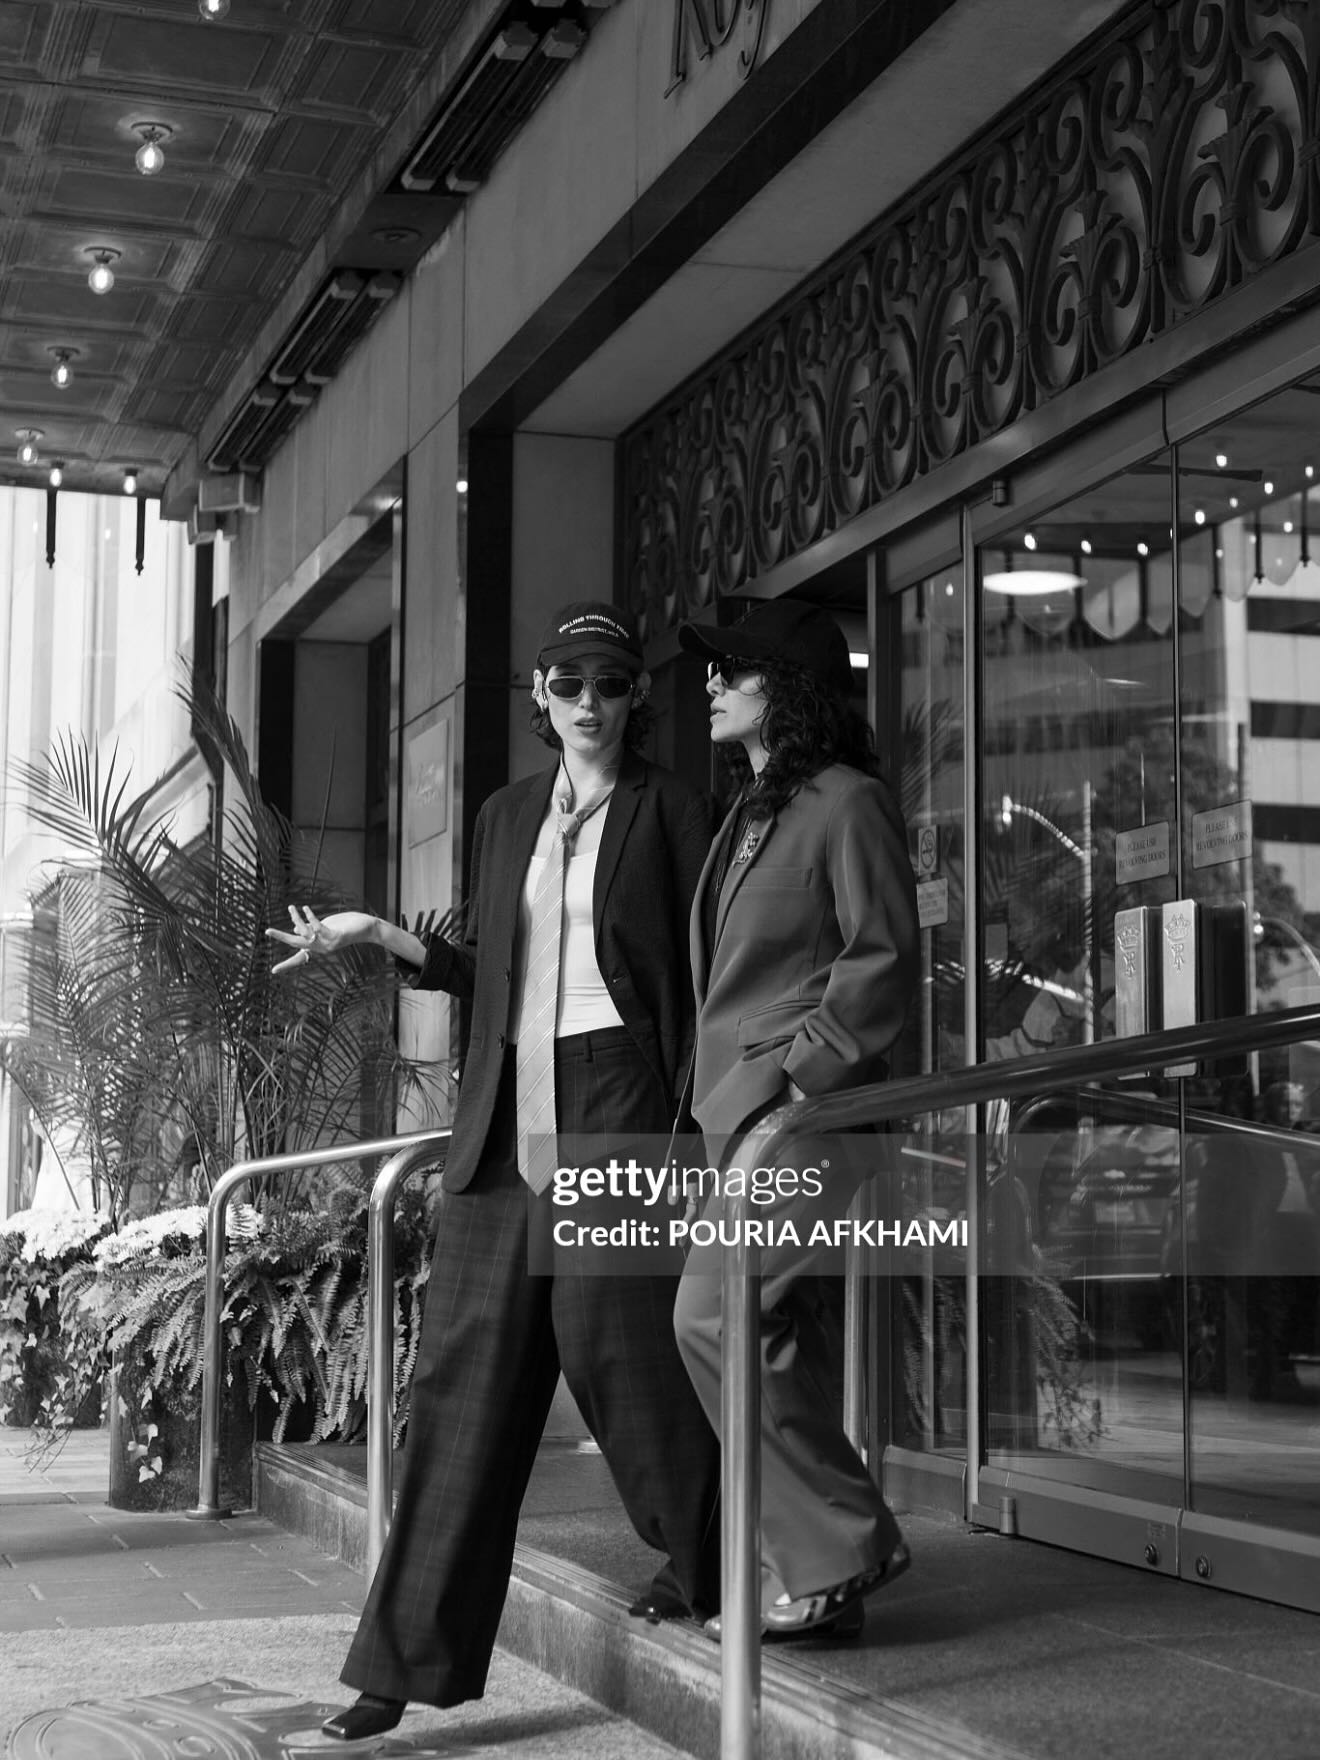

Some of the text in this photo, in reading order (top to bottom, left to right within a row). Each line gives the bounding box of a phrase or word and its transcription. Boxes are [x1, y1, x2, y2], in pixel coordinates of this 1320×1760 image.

[559, 615, 616, 633] ROLLING THROUGH
[1205, 821, 1226, 834] PLEASE
